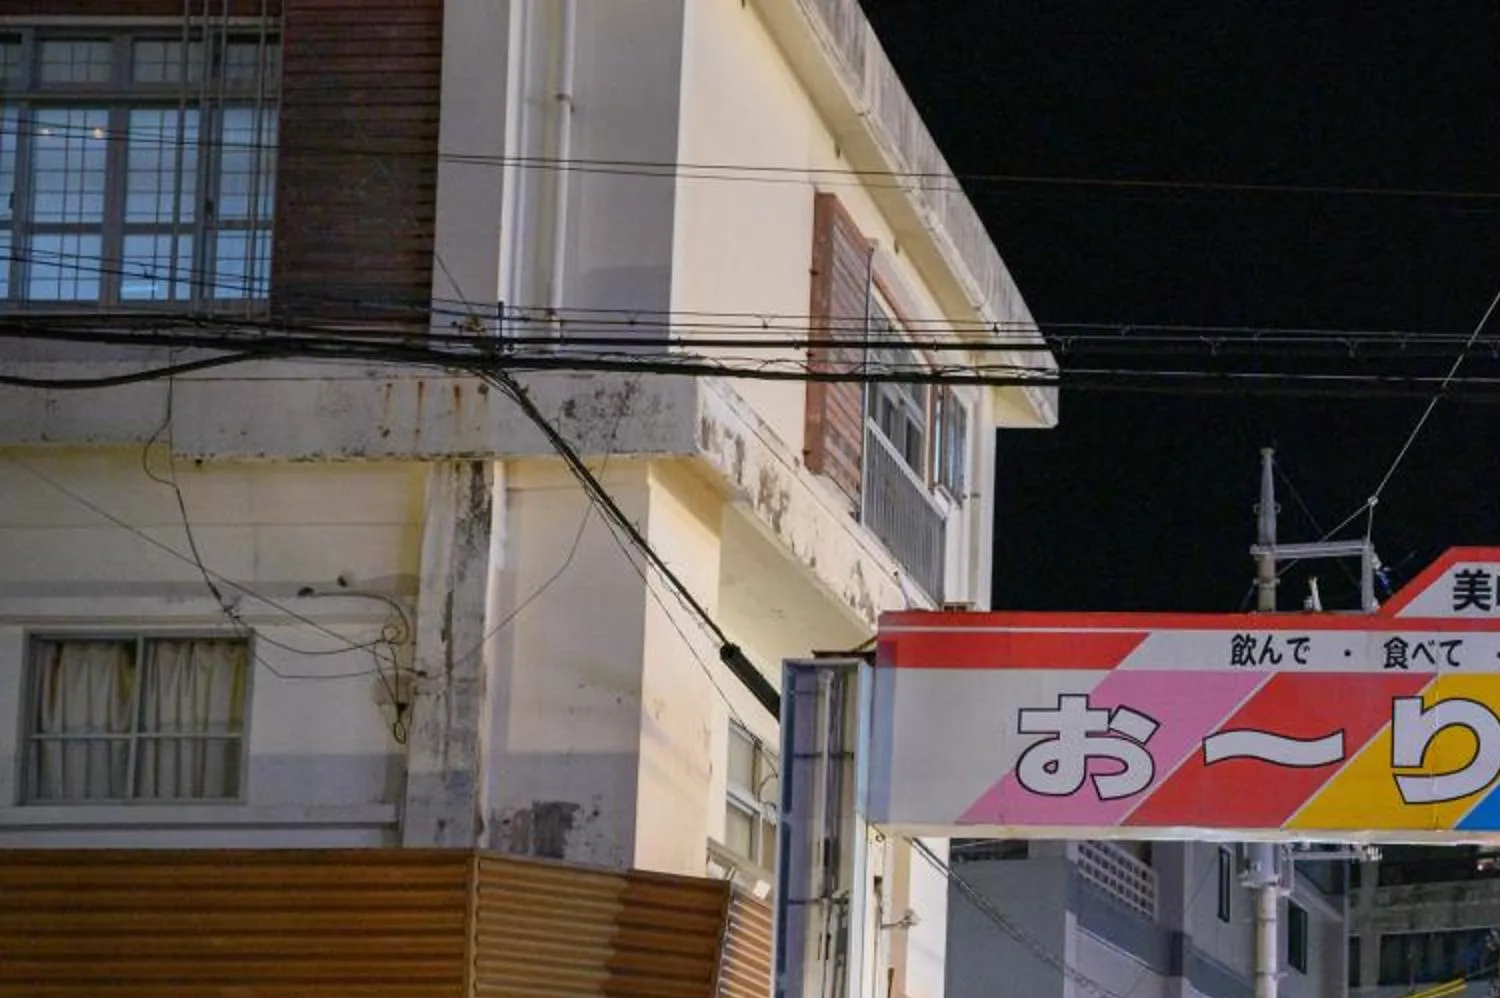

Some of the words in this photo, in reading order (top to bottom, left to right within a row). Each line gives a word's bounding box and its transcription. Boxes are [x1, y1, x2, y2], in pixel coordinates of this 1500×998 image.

[1230, 632, 1311, 668] 飲んで
[1383, 635, 1464, 669] 食べて
